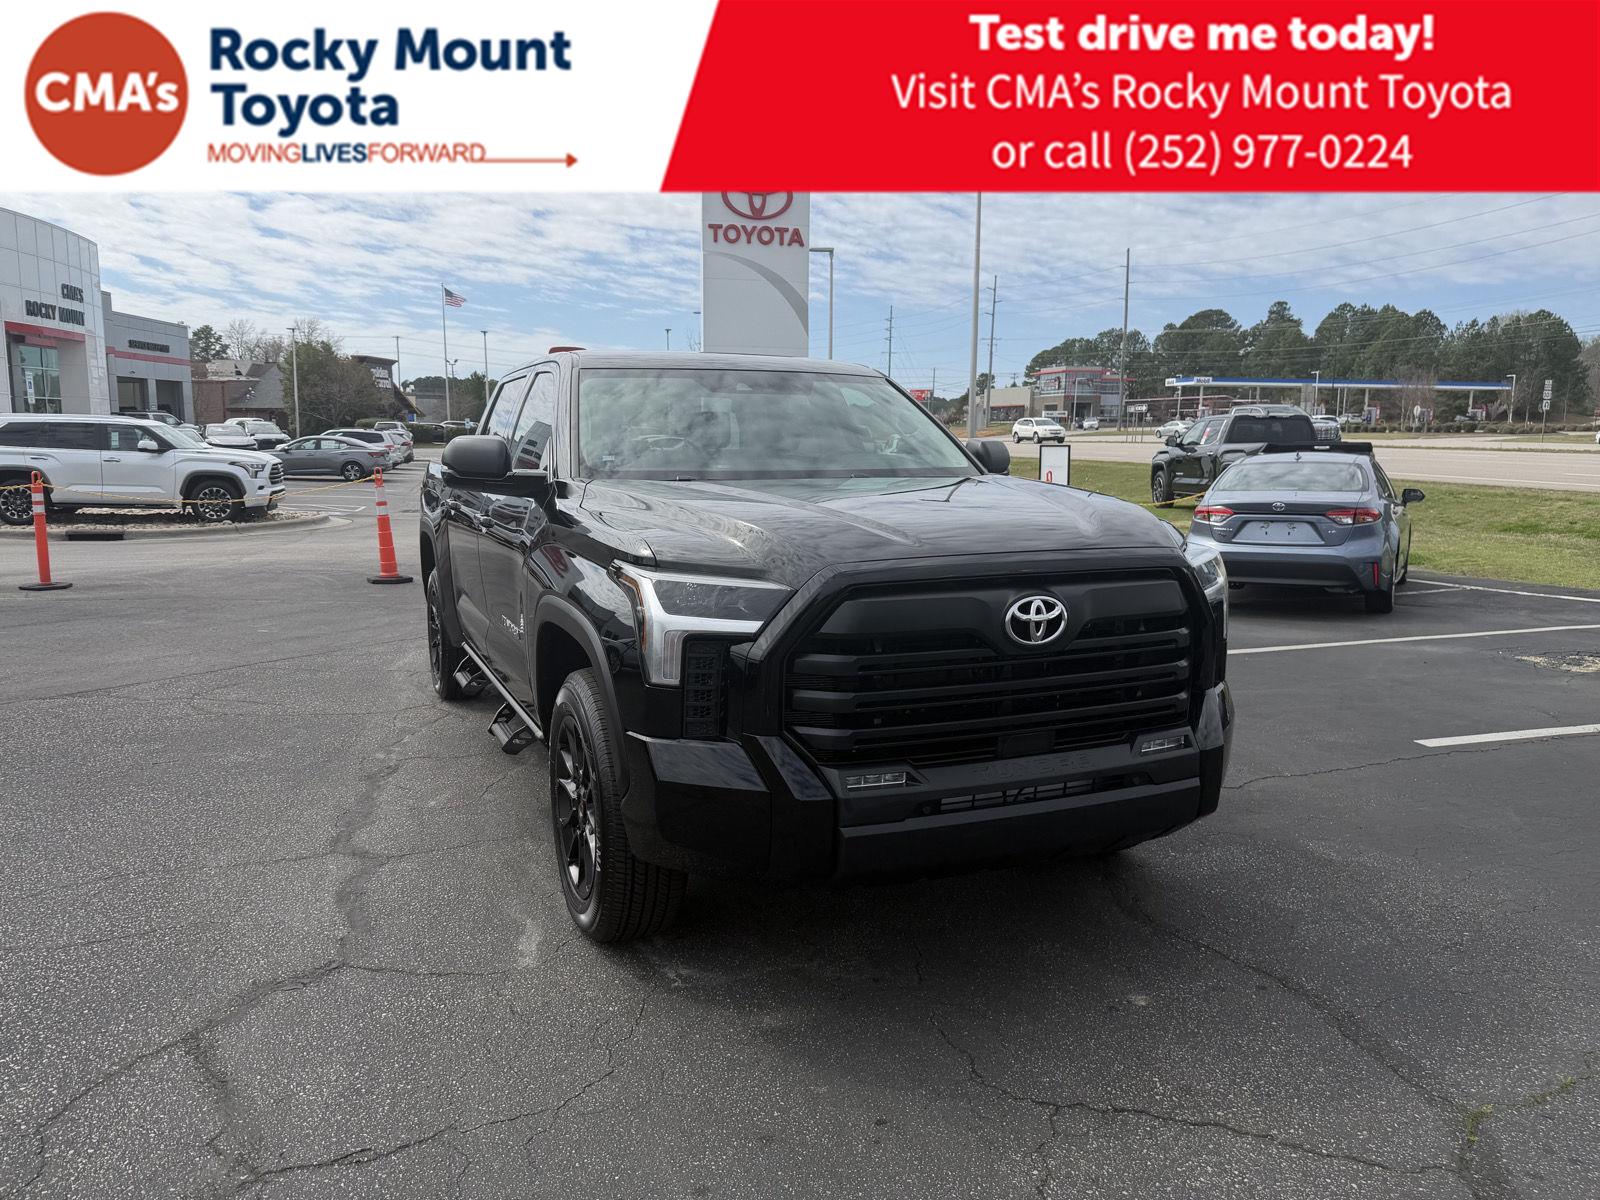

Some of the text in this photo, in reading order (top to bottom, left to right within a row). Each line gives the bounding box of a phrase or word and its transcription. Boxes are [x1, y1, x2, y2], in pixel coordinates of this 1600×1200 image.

[708, 223, 804, 247] TOYOTA
[25, 299, 85, 327] ROCKY MOUNT
